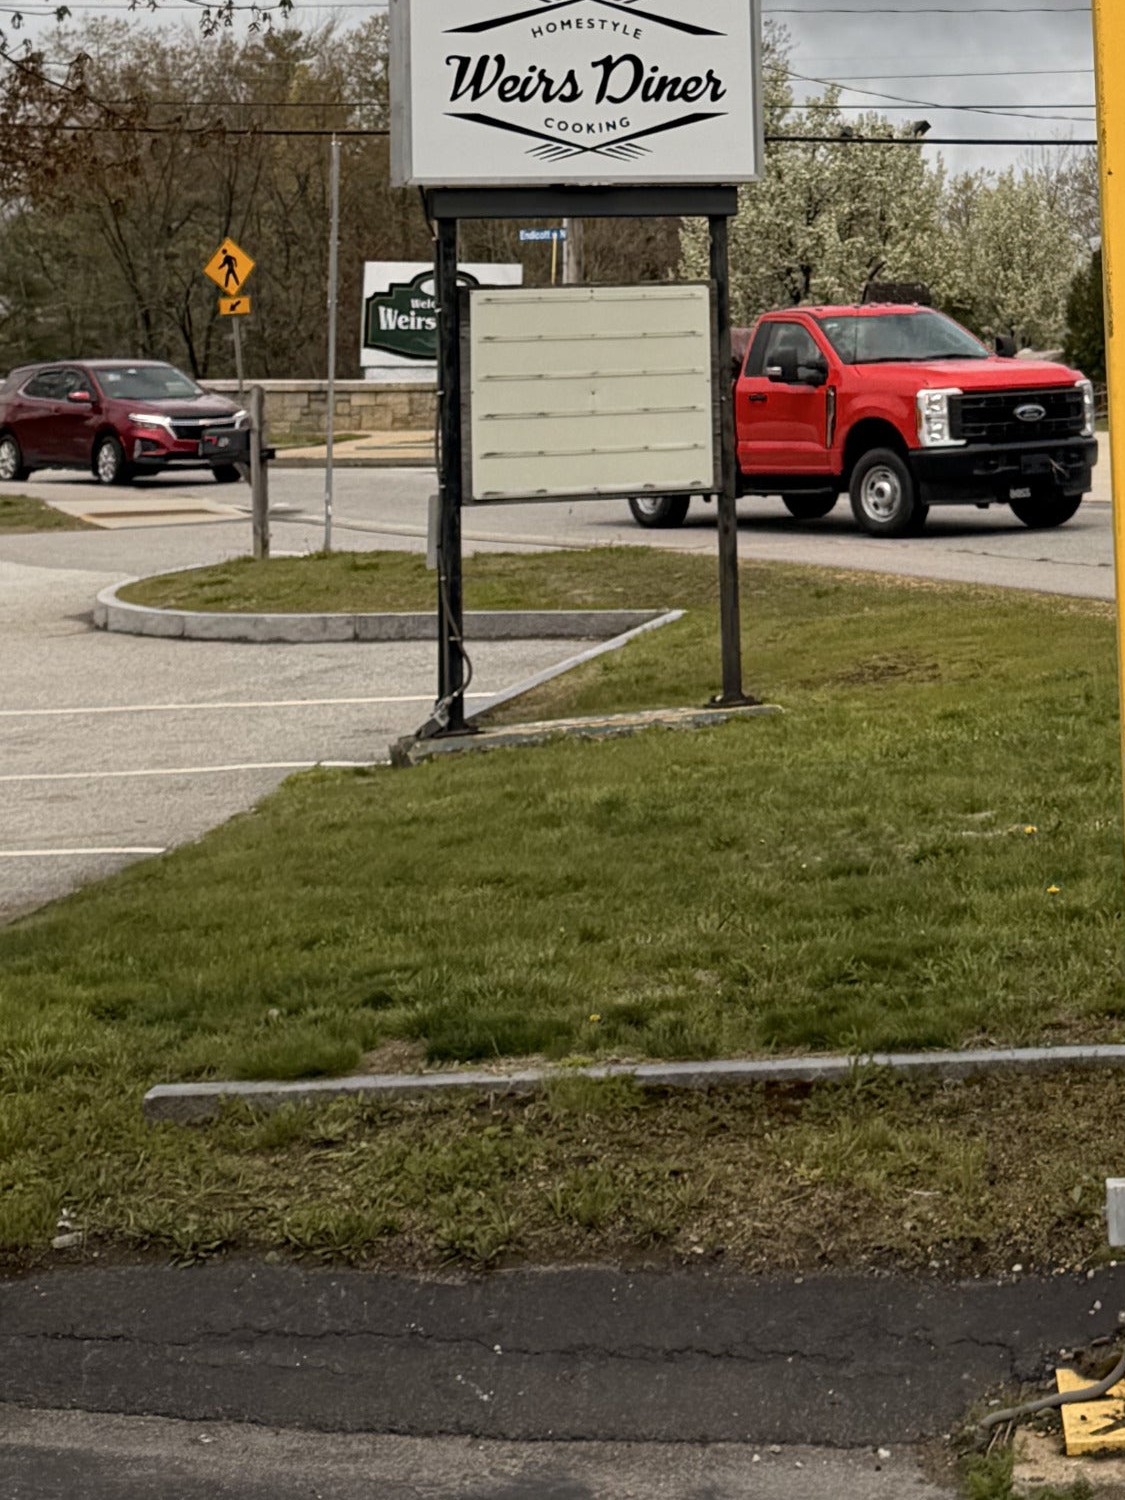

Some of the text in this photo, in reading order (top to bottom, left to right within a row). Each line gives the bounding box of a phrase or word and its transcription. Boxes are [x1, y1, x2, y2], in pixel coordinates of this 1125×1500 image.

[531, 17, 643, 41] HOMESTYLE
[445, 53, 726, 104] Weirs Diner
[543, 115, 632, 135] COOKING
[378, 305, 437, 331] Weirs
